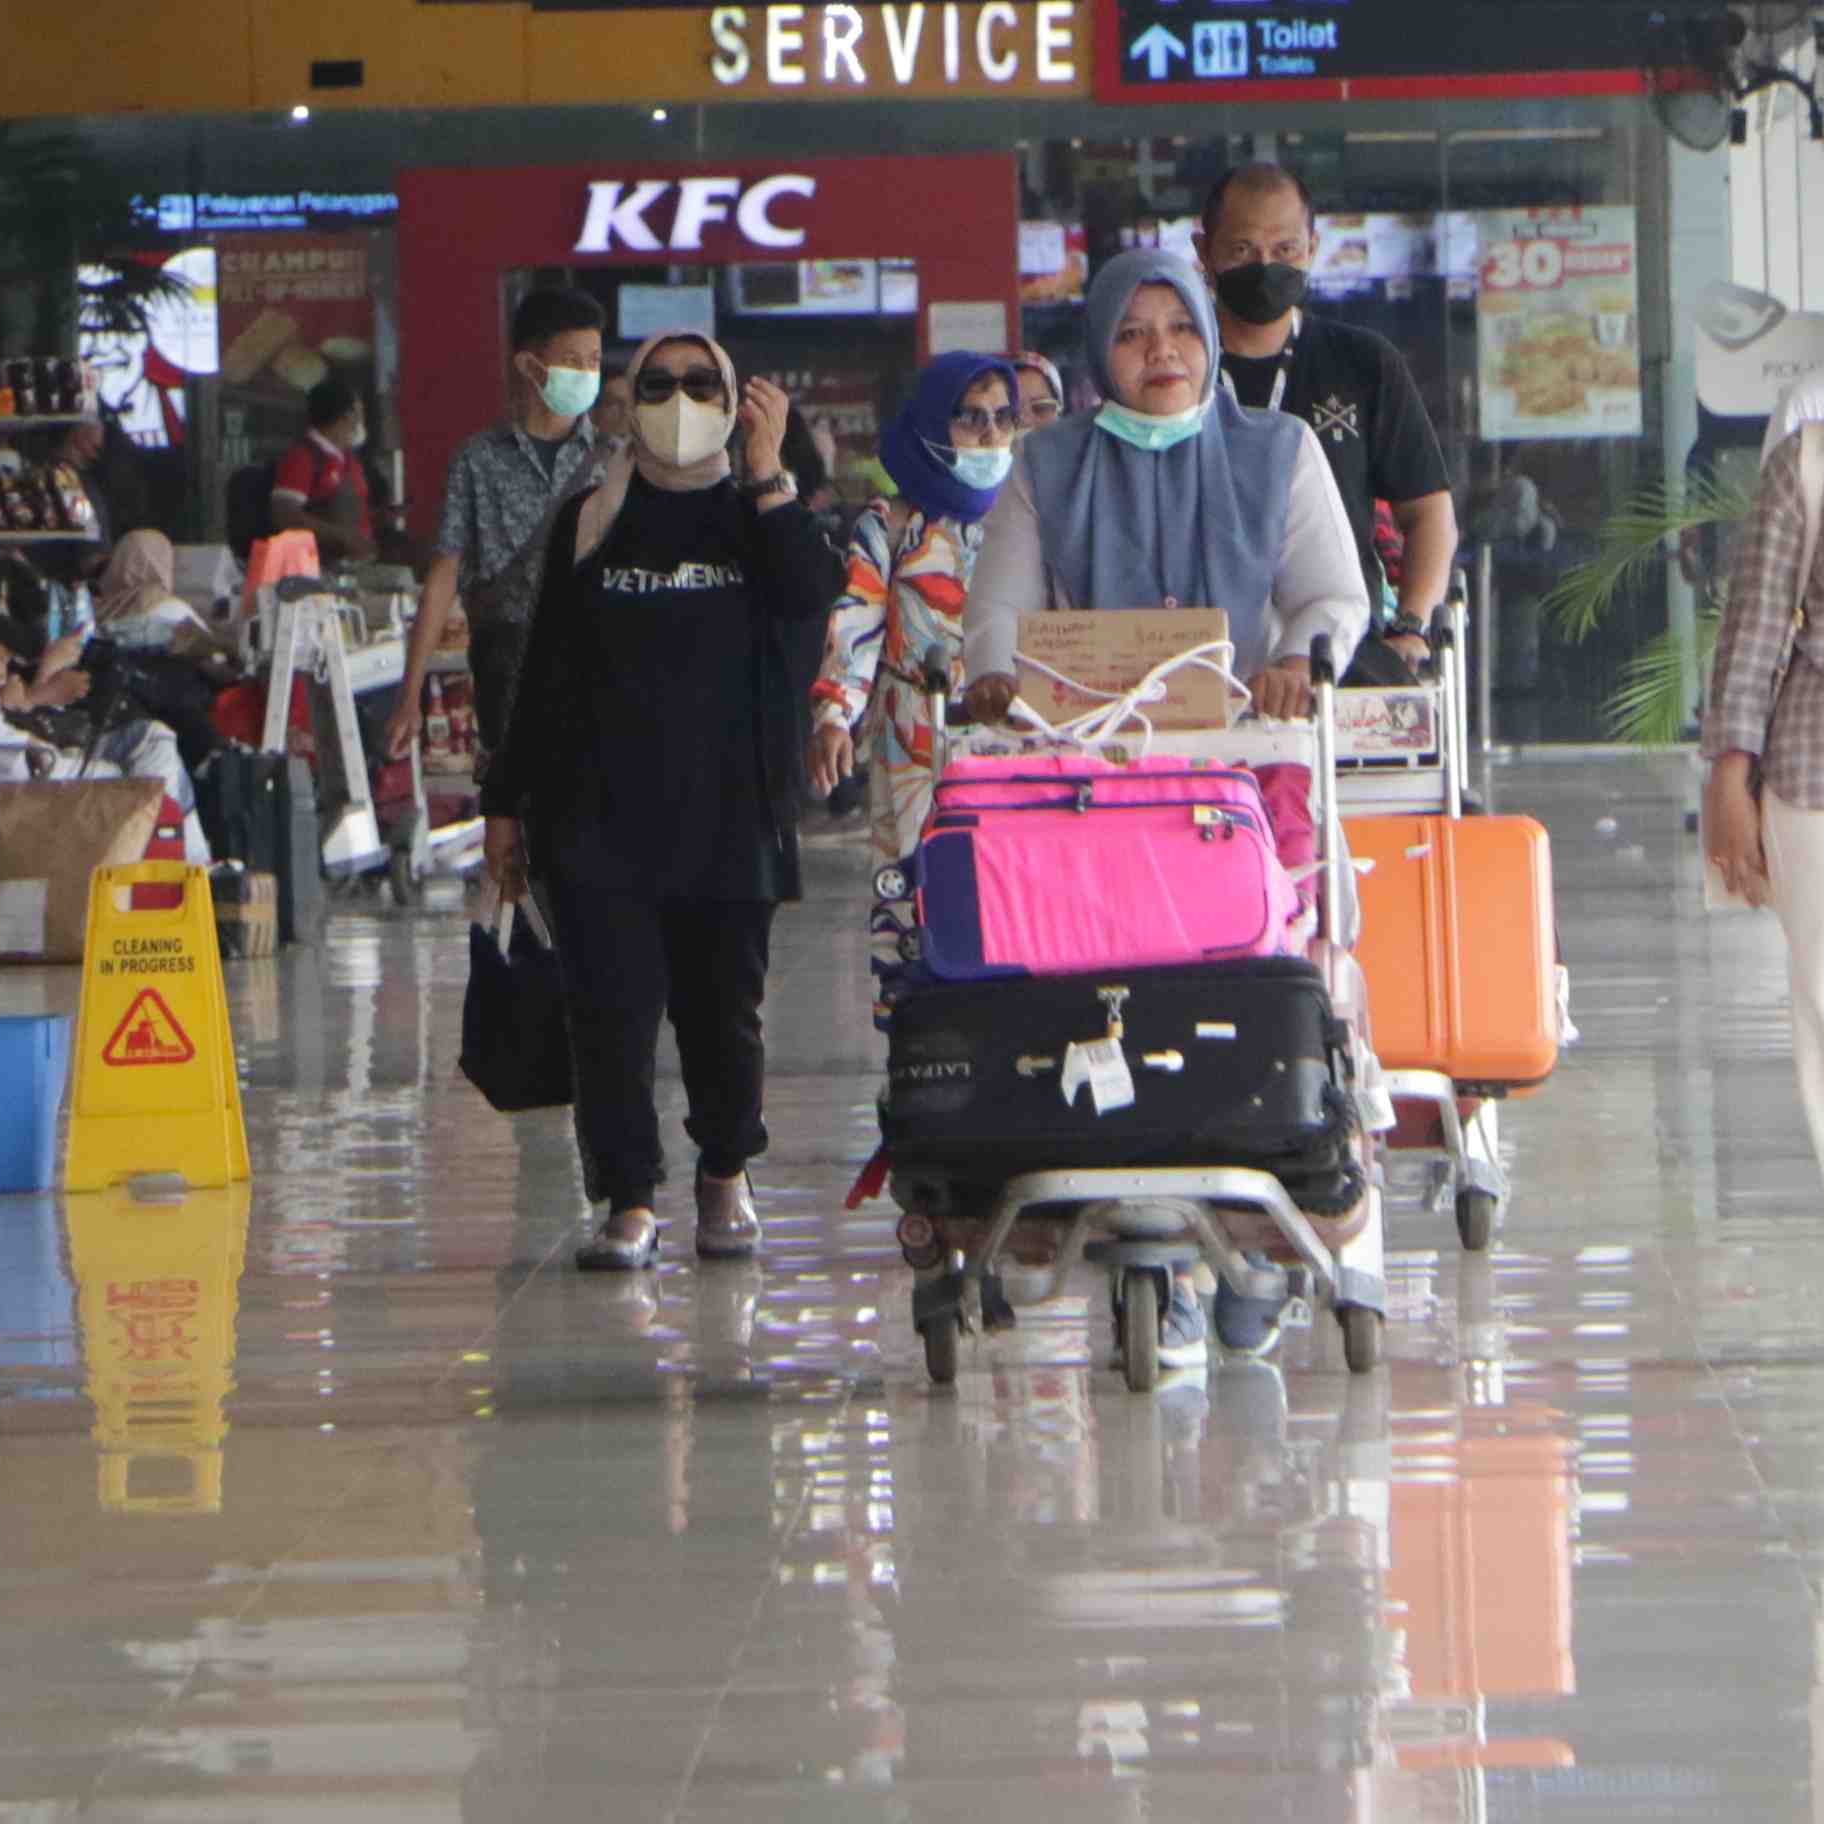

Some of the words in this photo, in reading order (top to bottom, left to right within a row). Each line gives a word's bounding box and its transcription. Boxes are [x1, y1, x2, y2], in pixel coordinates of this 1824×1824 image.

[711, 0, 1075, 85] SERVICE
[1255, 19, 1338, 51] Toilet
[1257, 54, 1316, 75] Toilets
[575, 174, 816, 253] KFC
[113, 938, 182, 955] CLEANING
[100, 958, 114, 974] IN
[120, 956, 195, 973] PROGRESS
